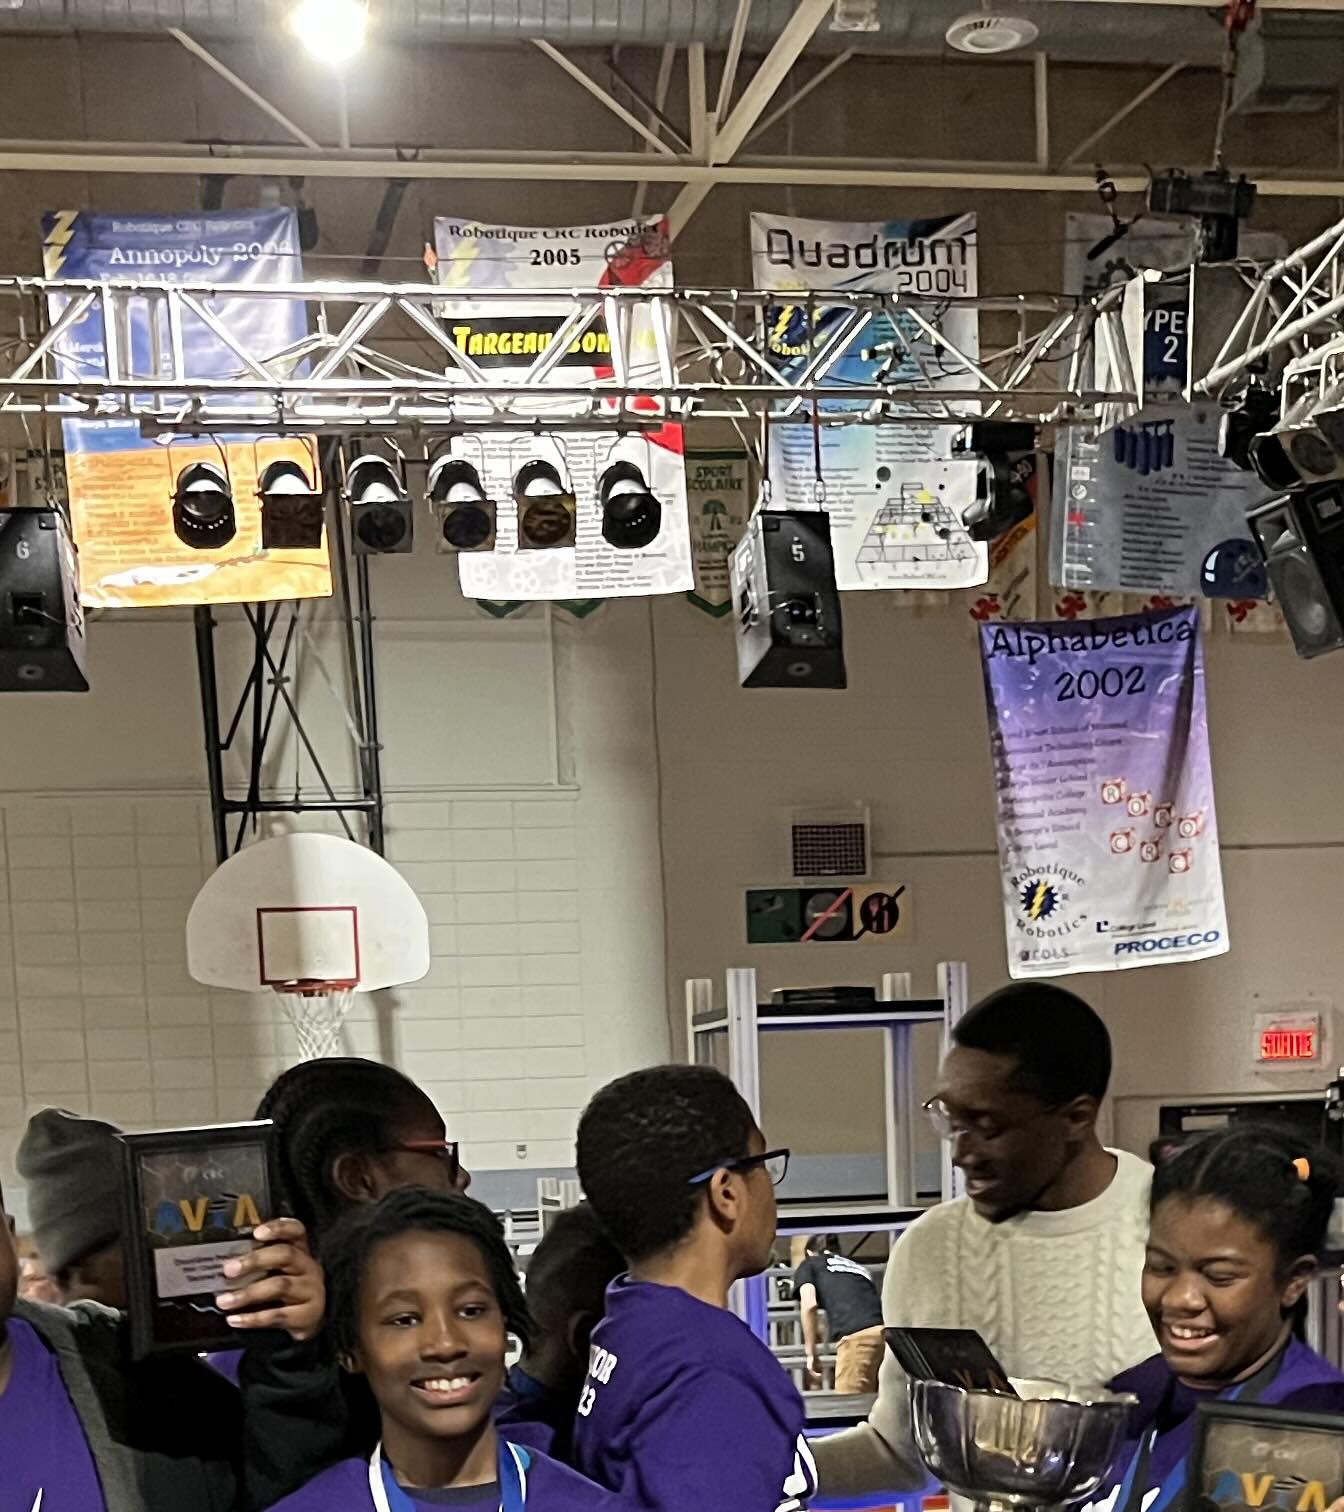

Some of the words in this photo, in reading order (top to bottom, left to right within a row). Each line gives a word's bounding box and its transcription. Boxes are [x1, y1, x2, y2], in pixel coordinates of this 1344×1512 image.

[449, 224, 538, 243] Robotique
[542, 228, 581, 241] CRC
[110, 246, 224, 269] Annopoly
[529, 248, 583, 267] 2005
[766, 229, 967, 270] Quadrum
[897, 269, 968, 293] 2004
[1162, 336, 1179, 364] 2
[16, 540, 30, 559] 6
[791, 543, 805, 563] 5
[986, 618, 1197, 666] Alphabetica
[1054, 665, 1147, 702] 2002
[1114, 930, 1221, 956] PROCECO
[1261, 1030, 1314, 1058] SORTIE
